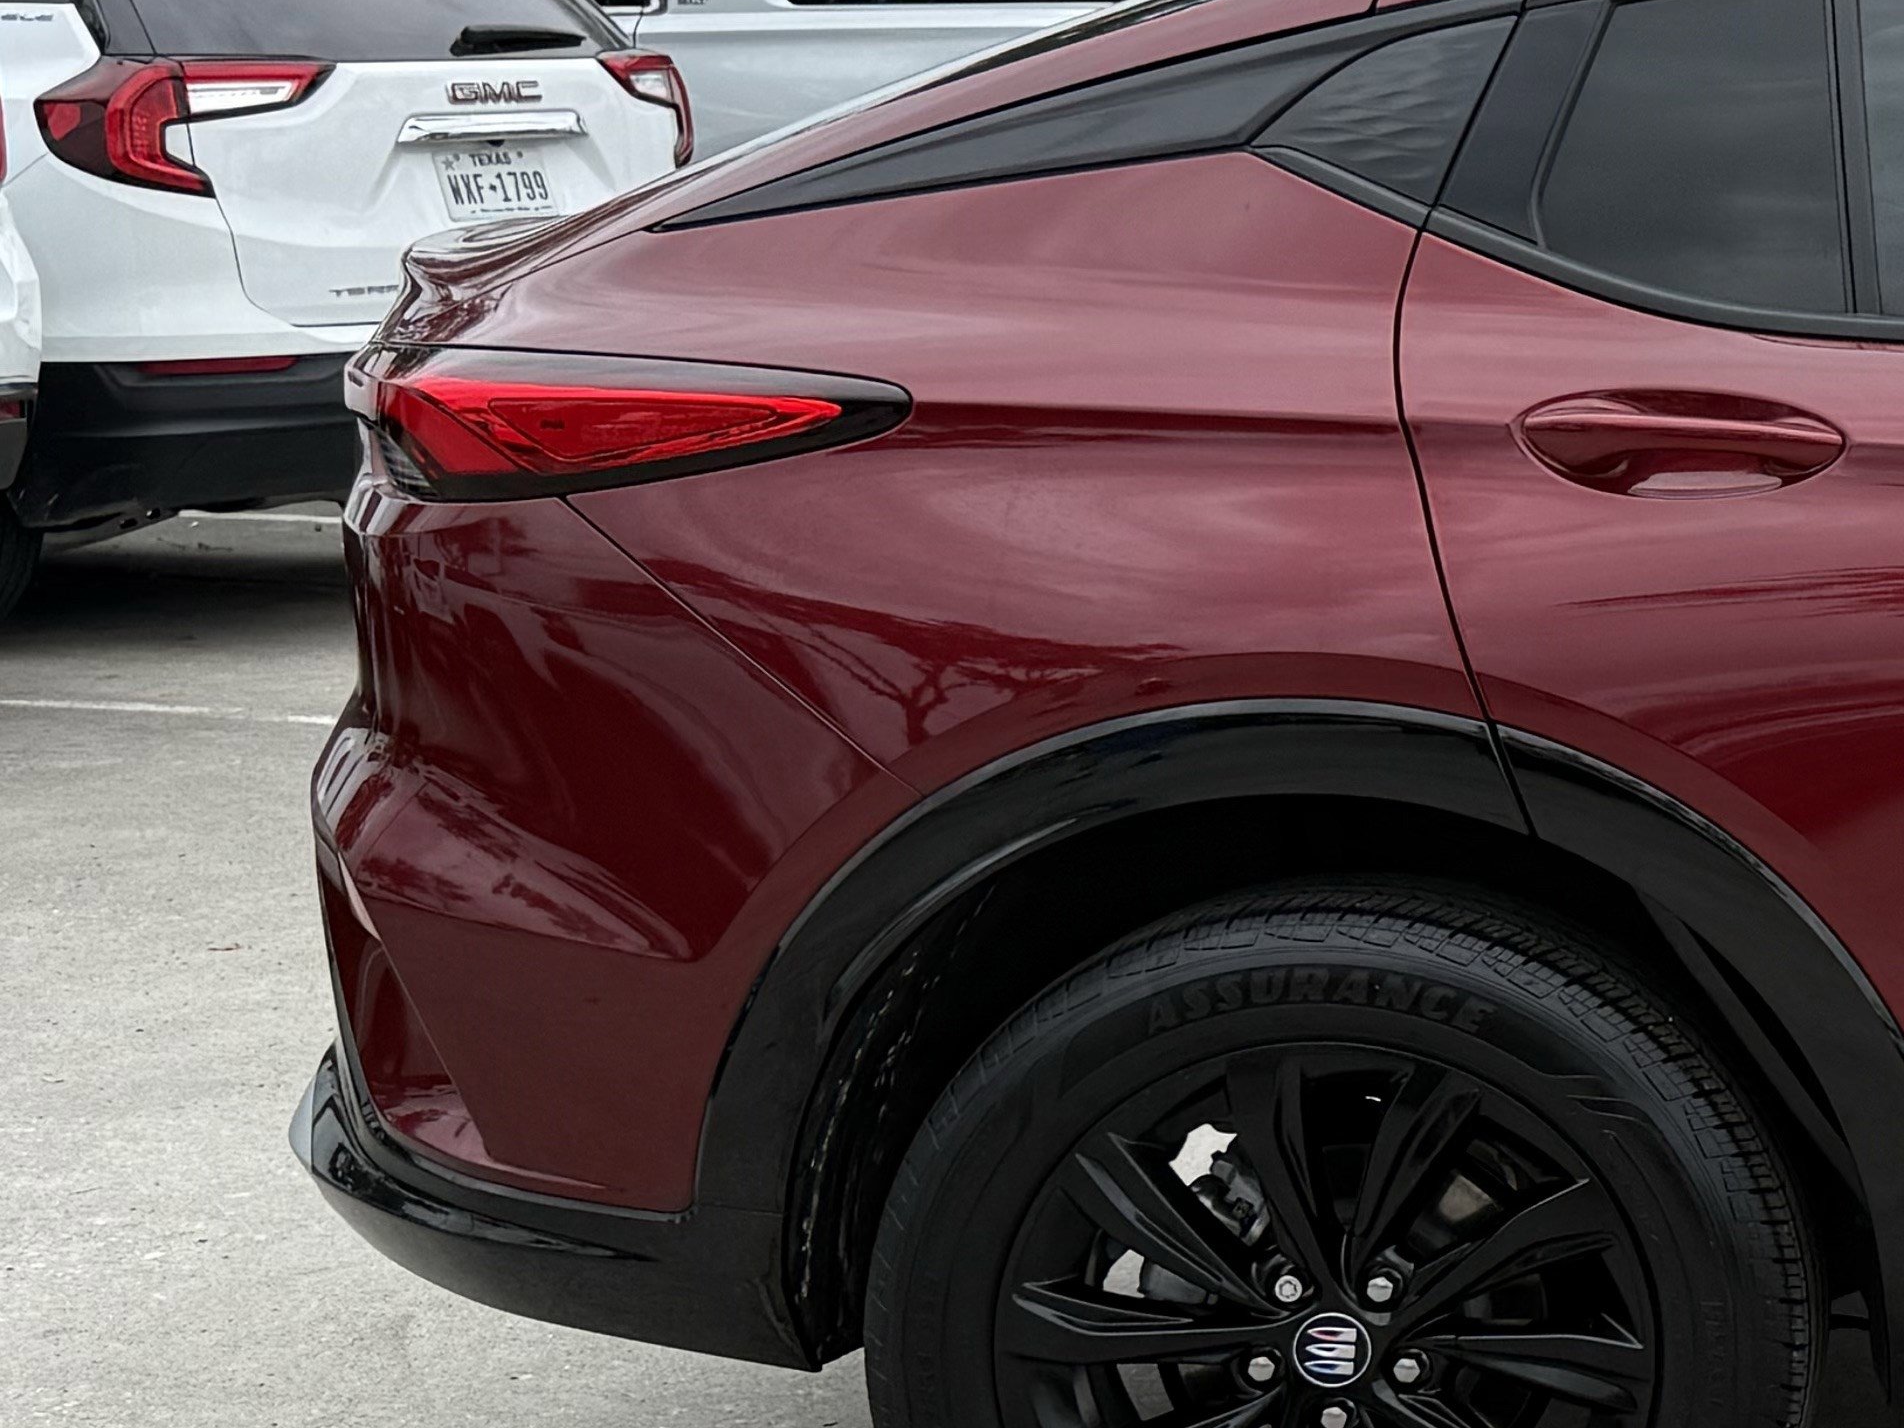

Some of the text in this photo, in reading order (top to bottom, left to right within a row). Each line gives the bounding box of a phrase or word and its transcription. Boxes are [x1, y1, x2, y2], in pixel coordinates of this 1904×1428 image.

[446, 80, 543, 105] GMC
[469, 151, 512, 167] TEXAS
[1148, 967, 1499, 1035] ASSURANCE
